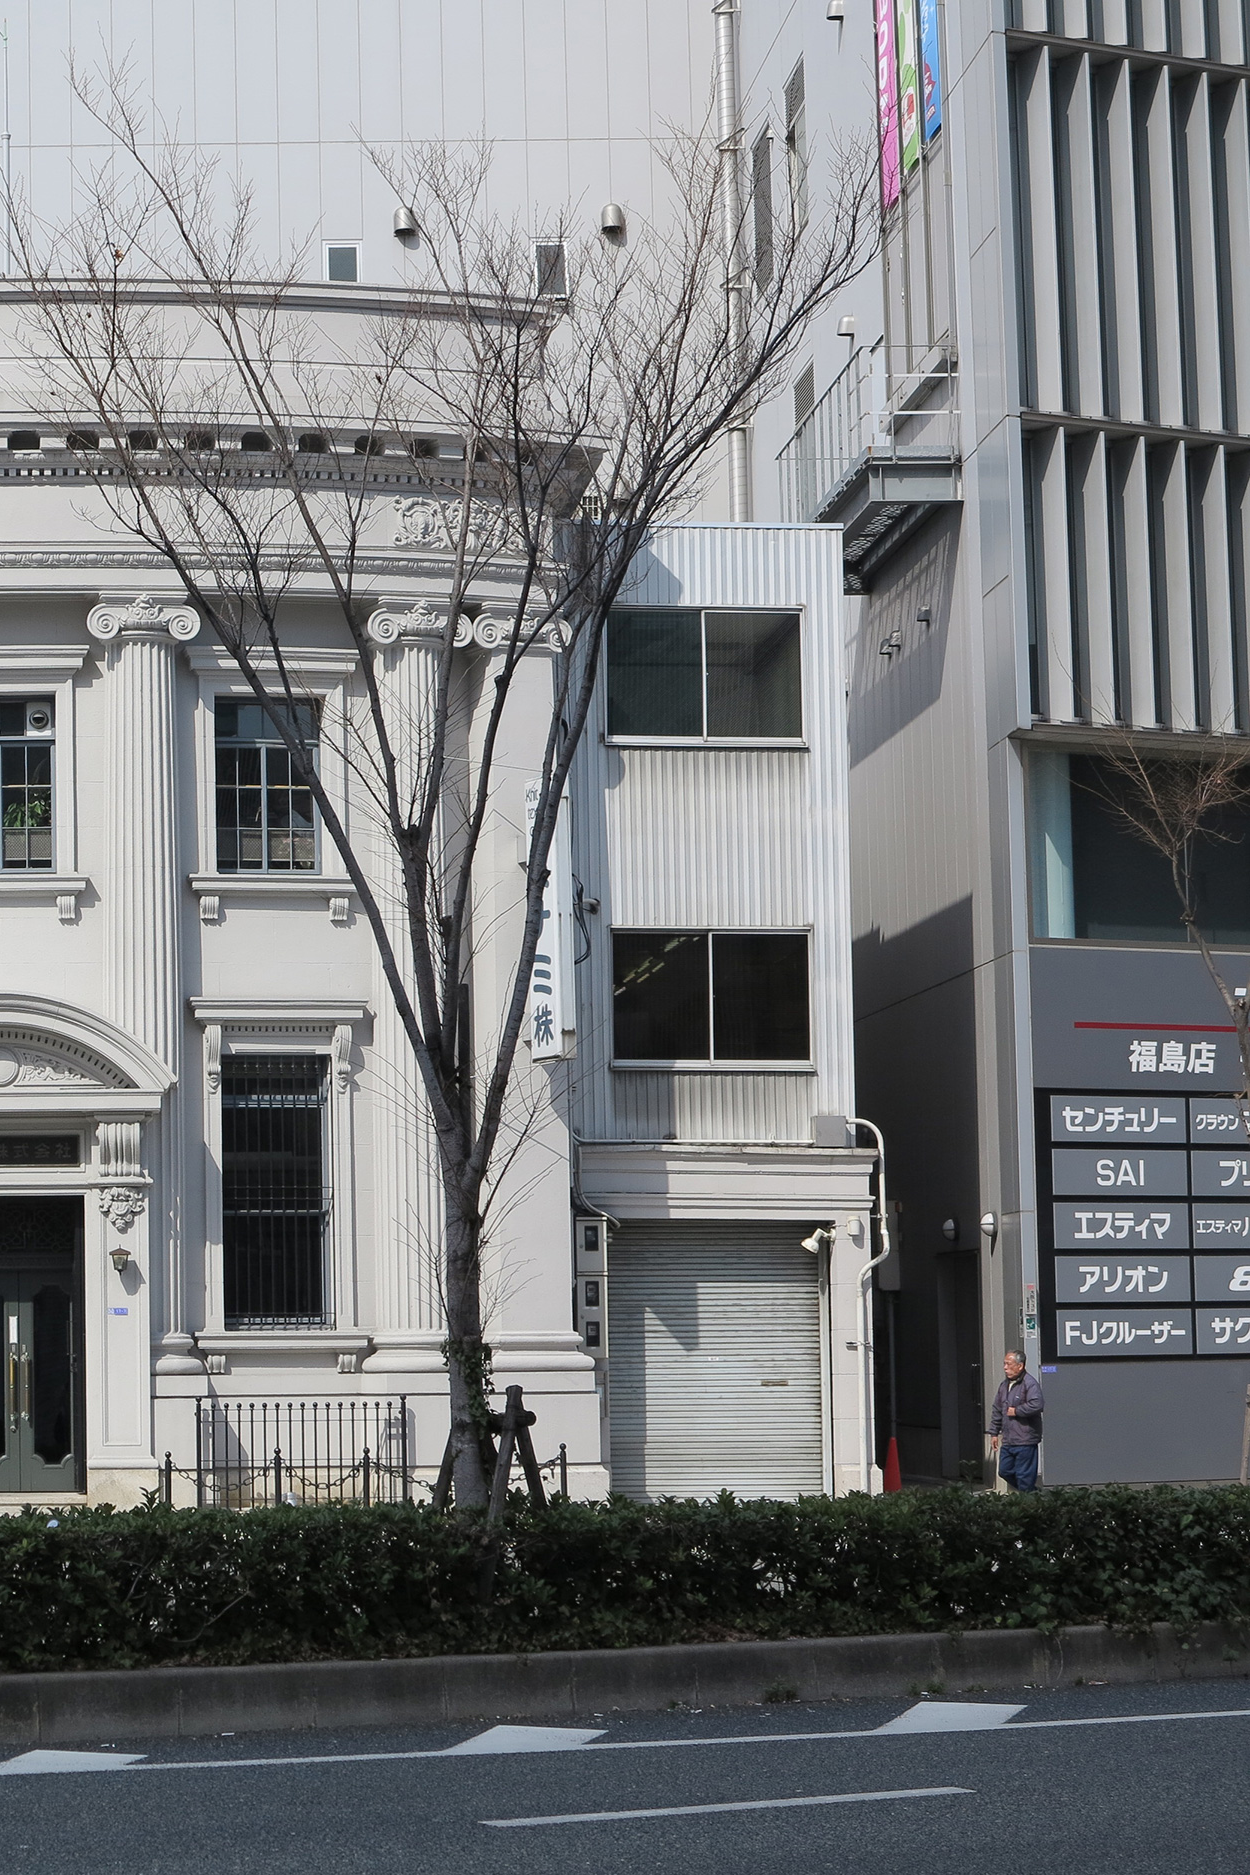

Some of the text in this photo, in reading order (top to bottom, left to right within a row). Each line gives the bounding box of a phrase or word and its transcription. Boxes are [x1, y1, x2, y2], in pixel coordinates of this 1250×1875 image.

[1128, 1040, 1217, 1074] 福島店
[1062, 1106, 1177, 1133] センチュリー
[1096, 1159, 1145, 1186] SAI
[1074, 1212, 1171, 1240] エスティマ
[1078, 1265, 1169, 1293] アリオン
[1065, 1320, 1186, 1346] FJクルーザー
